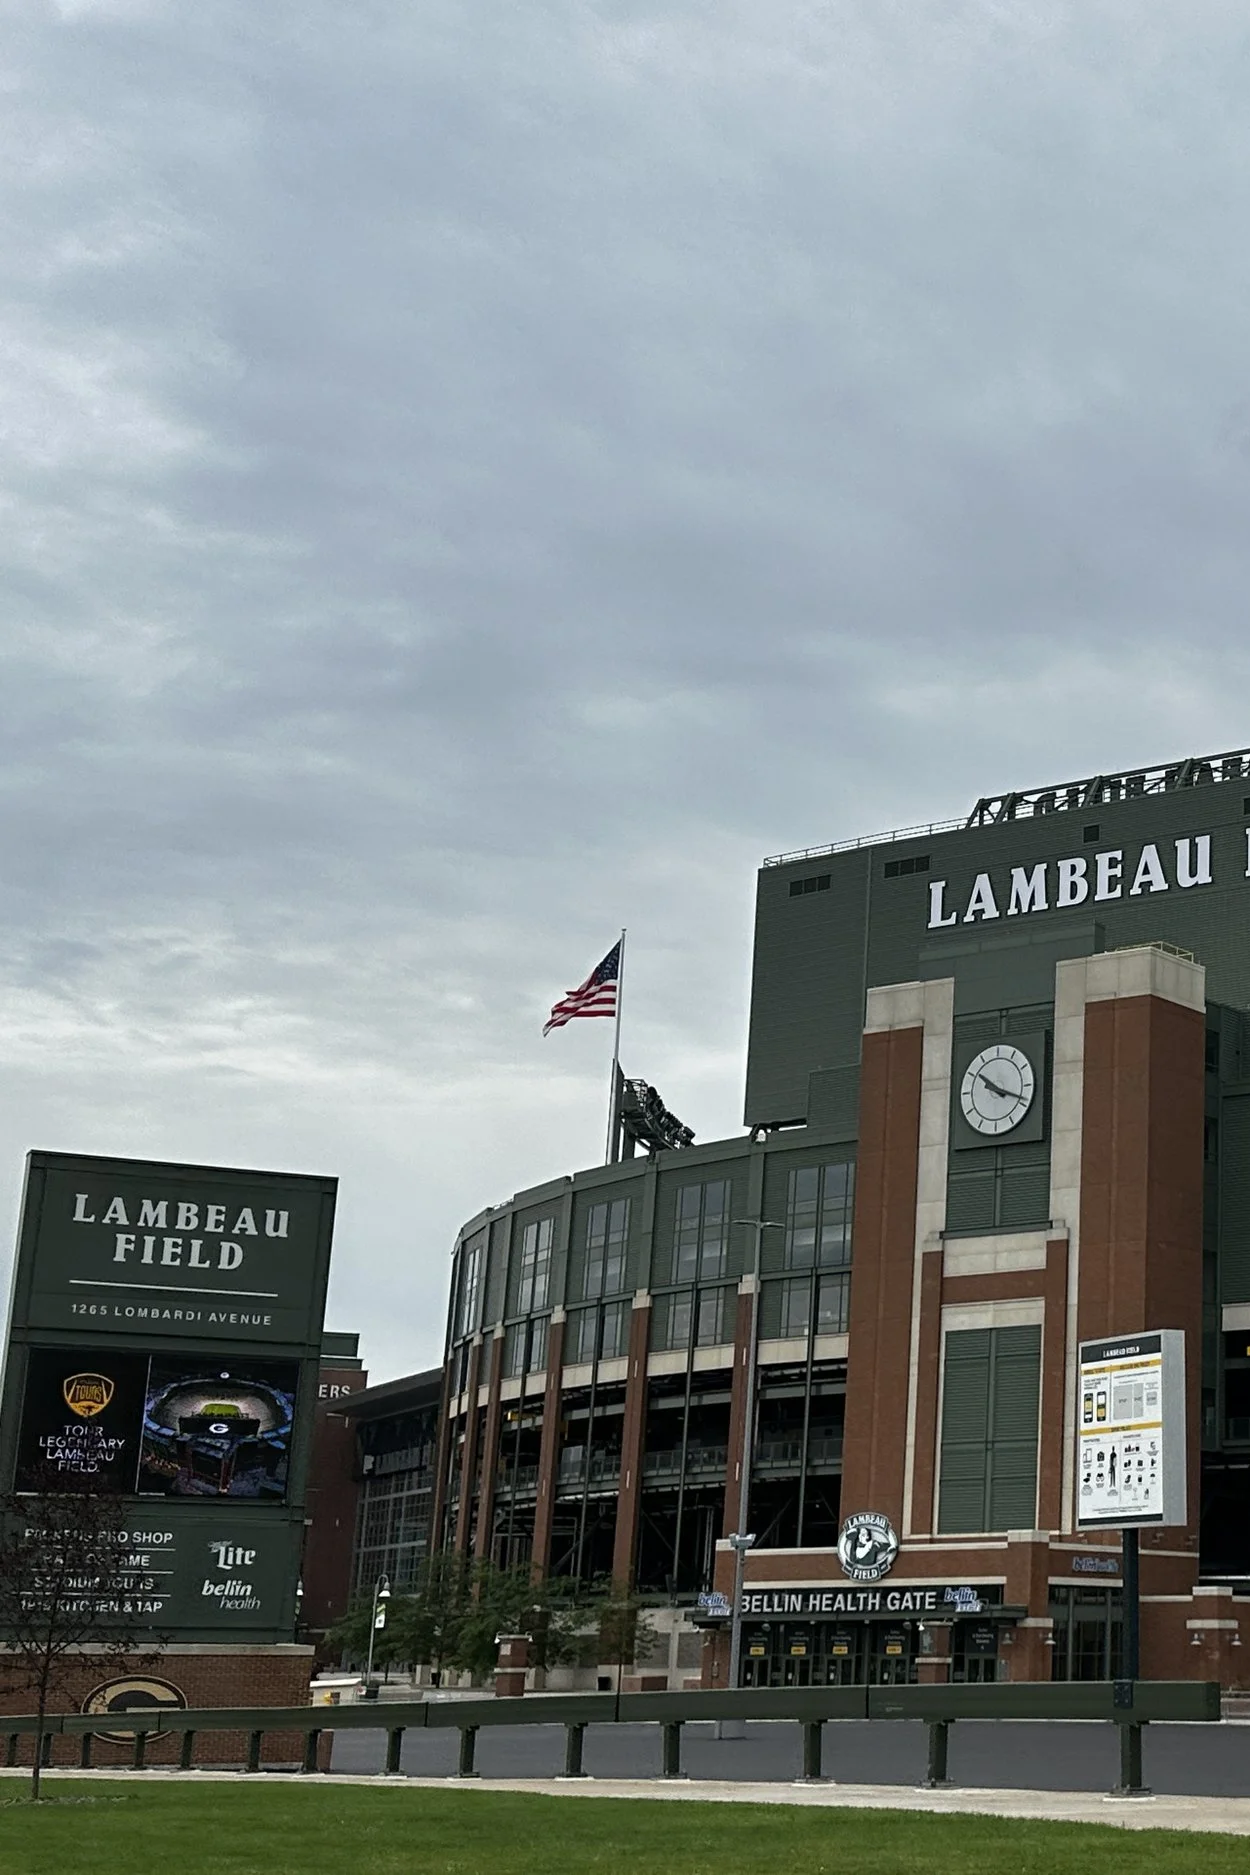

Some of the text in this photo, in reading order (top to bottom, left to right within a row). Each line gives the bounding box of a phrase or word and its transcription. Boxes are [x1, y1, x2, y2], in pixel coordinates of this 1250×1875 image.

[928, 834, 1212, 929] LAMBEAU
[72, 1193, 289, 1238] LAMBEAU
[112, 1233, 243, 1270] FIELD
[72, 1304, 272, 1325] 1265 LOMBARDI AVENUE
[64, 1425, 104, 1436] TOUR
[39, 1436, 125, 1449] LEGENARY
[848, 1514, 886, 1529] LAMBEAU
[132, 1531, 173, 1544] SHOP
[217, 1546, 256, 1570] Lite
[853, 1569, 878, 1579] FIELD
[202, 1580, 252, 1596] bellin
[944, 1587, 978, 1602] bellin
[123, 1602, 132, 1612] &
[136, 1601, 163, 1612] TAP
[220, 1596, 261, 1610] health
[742, 1594, 802, 1612] BELLIN
[808, 1593, 880, 1611] HEALTH
[887, 1592, 937, 1610] GATE
